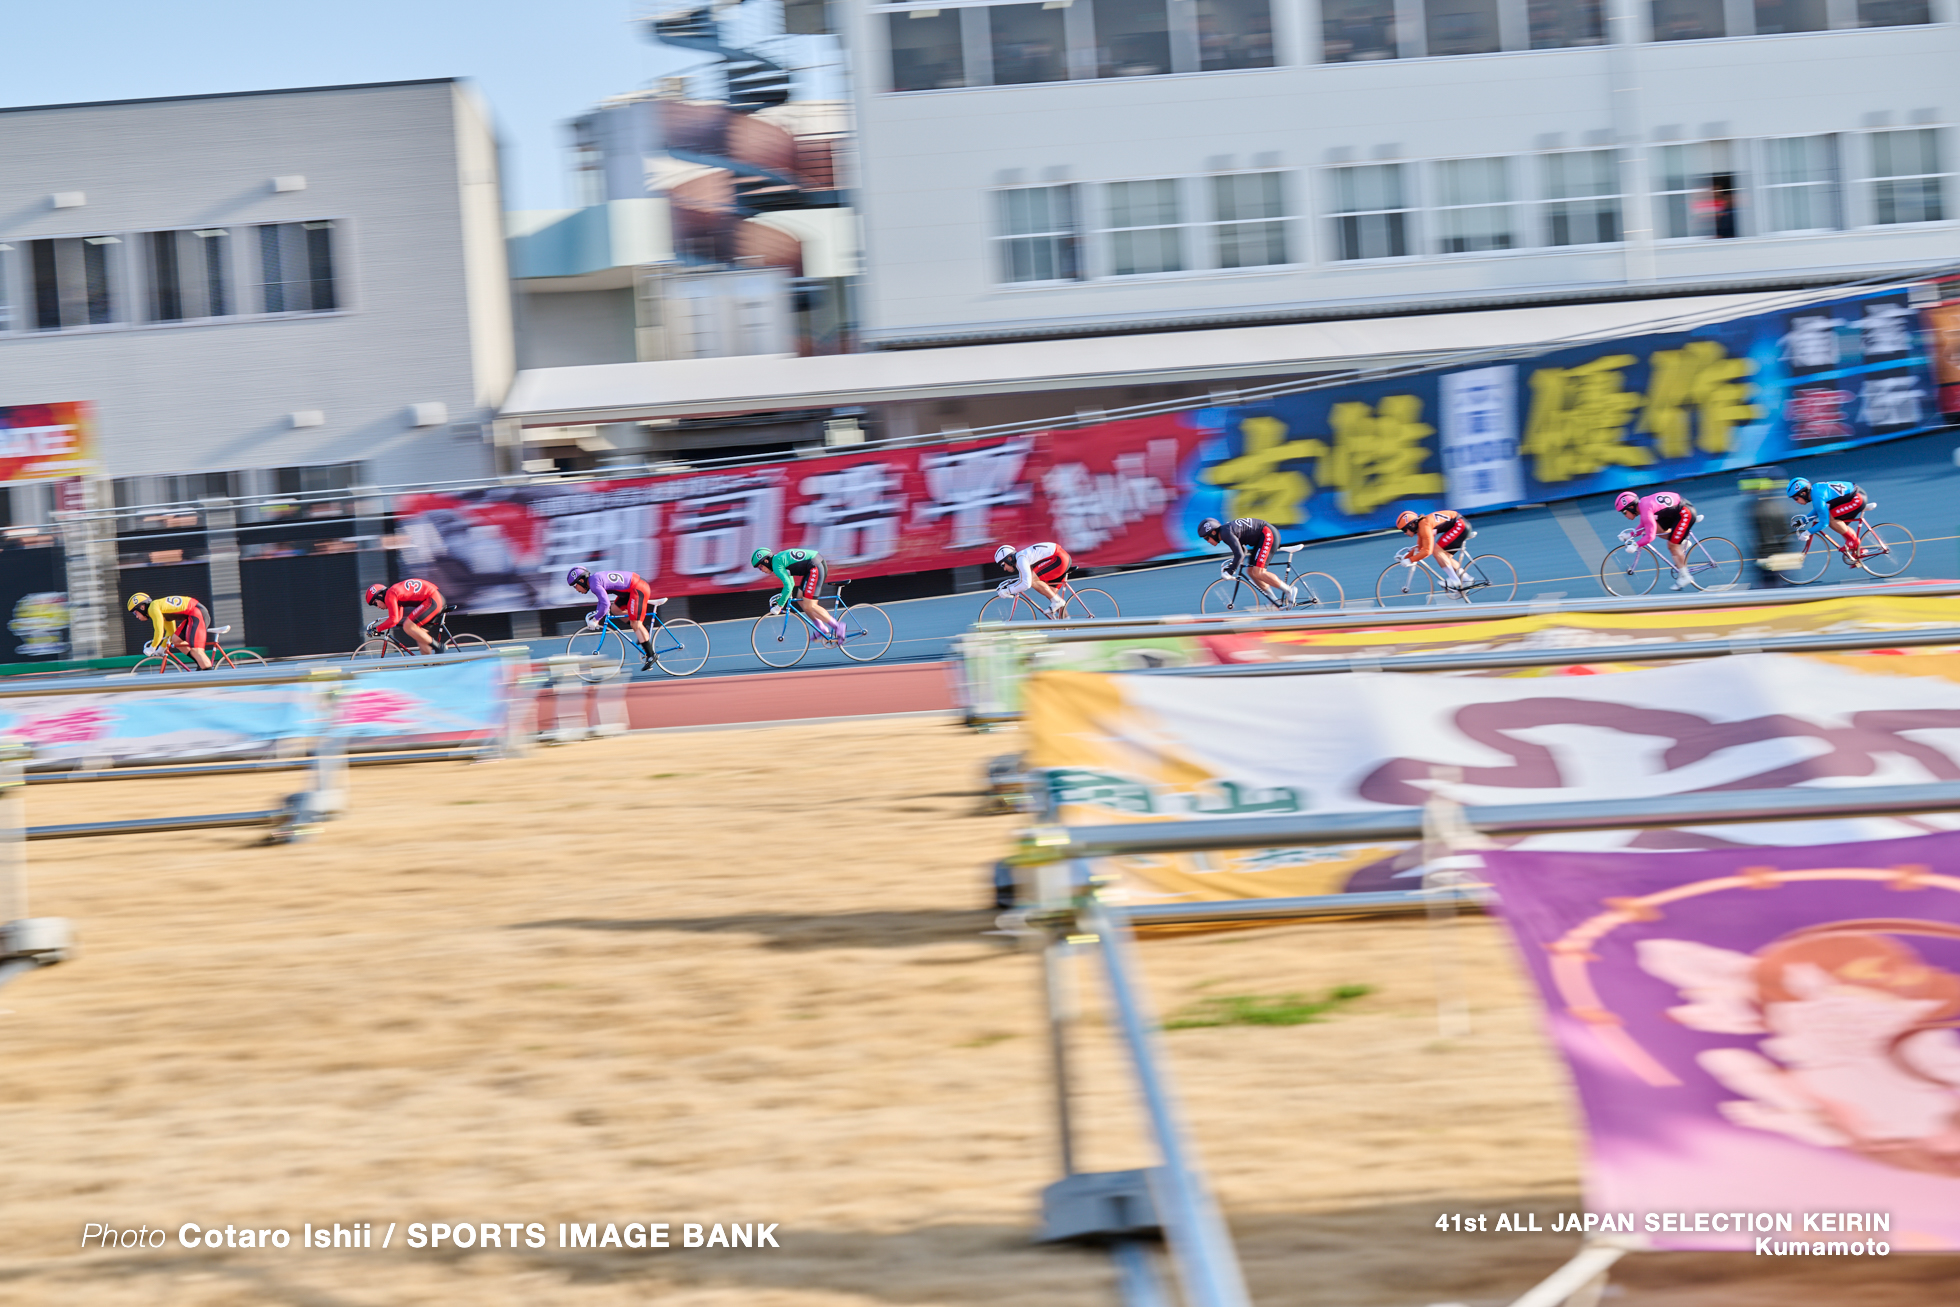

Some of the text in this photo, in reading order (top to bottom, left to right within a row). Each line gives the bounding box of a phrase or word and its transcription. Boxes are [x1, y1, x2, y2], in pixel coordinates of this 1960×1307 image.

[1828, 483, 1847, 496] 4
[1656, 495, 1673, 508] 8
[1433, 513, 1450, 522] 7
[1203, 522, 1211, 532] 2
[1235, 518, 1252, 528] 2
[756, 550, 762, 560] 6
[790, 550, 806, 561] 6
[570, 570, 577, 579] 9
[606, 572, 624, 584] 9
[369, 586, 377, 594] 3
[404, 579, 422, 593] 3
[132, 596, 139, 605] 5
[165, 595, 183, 607] 5
